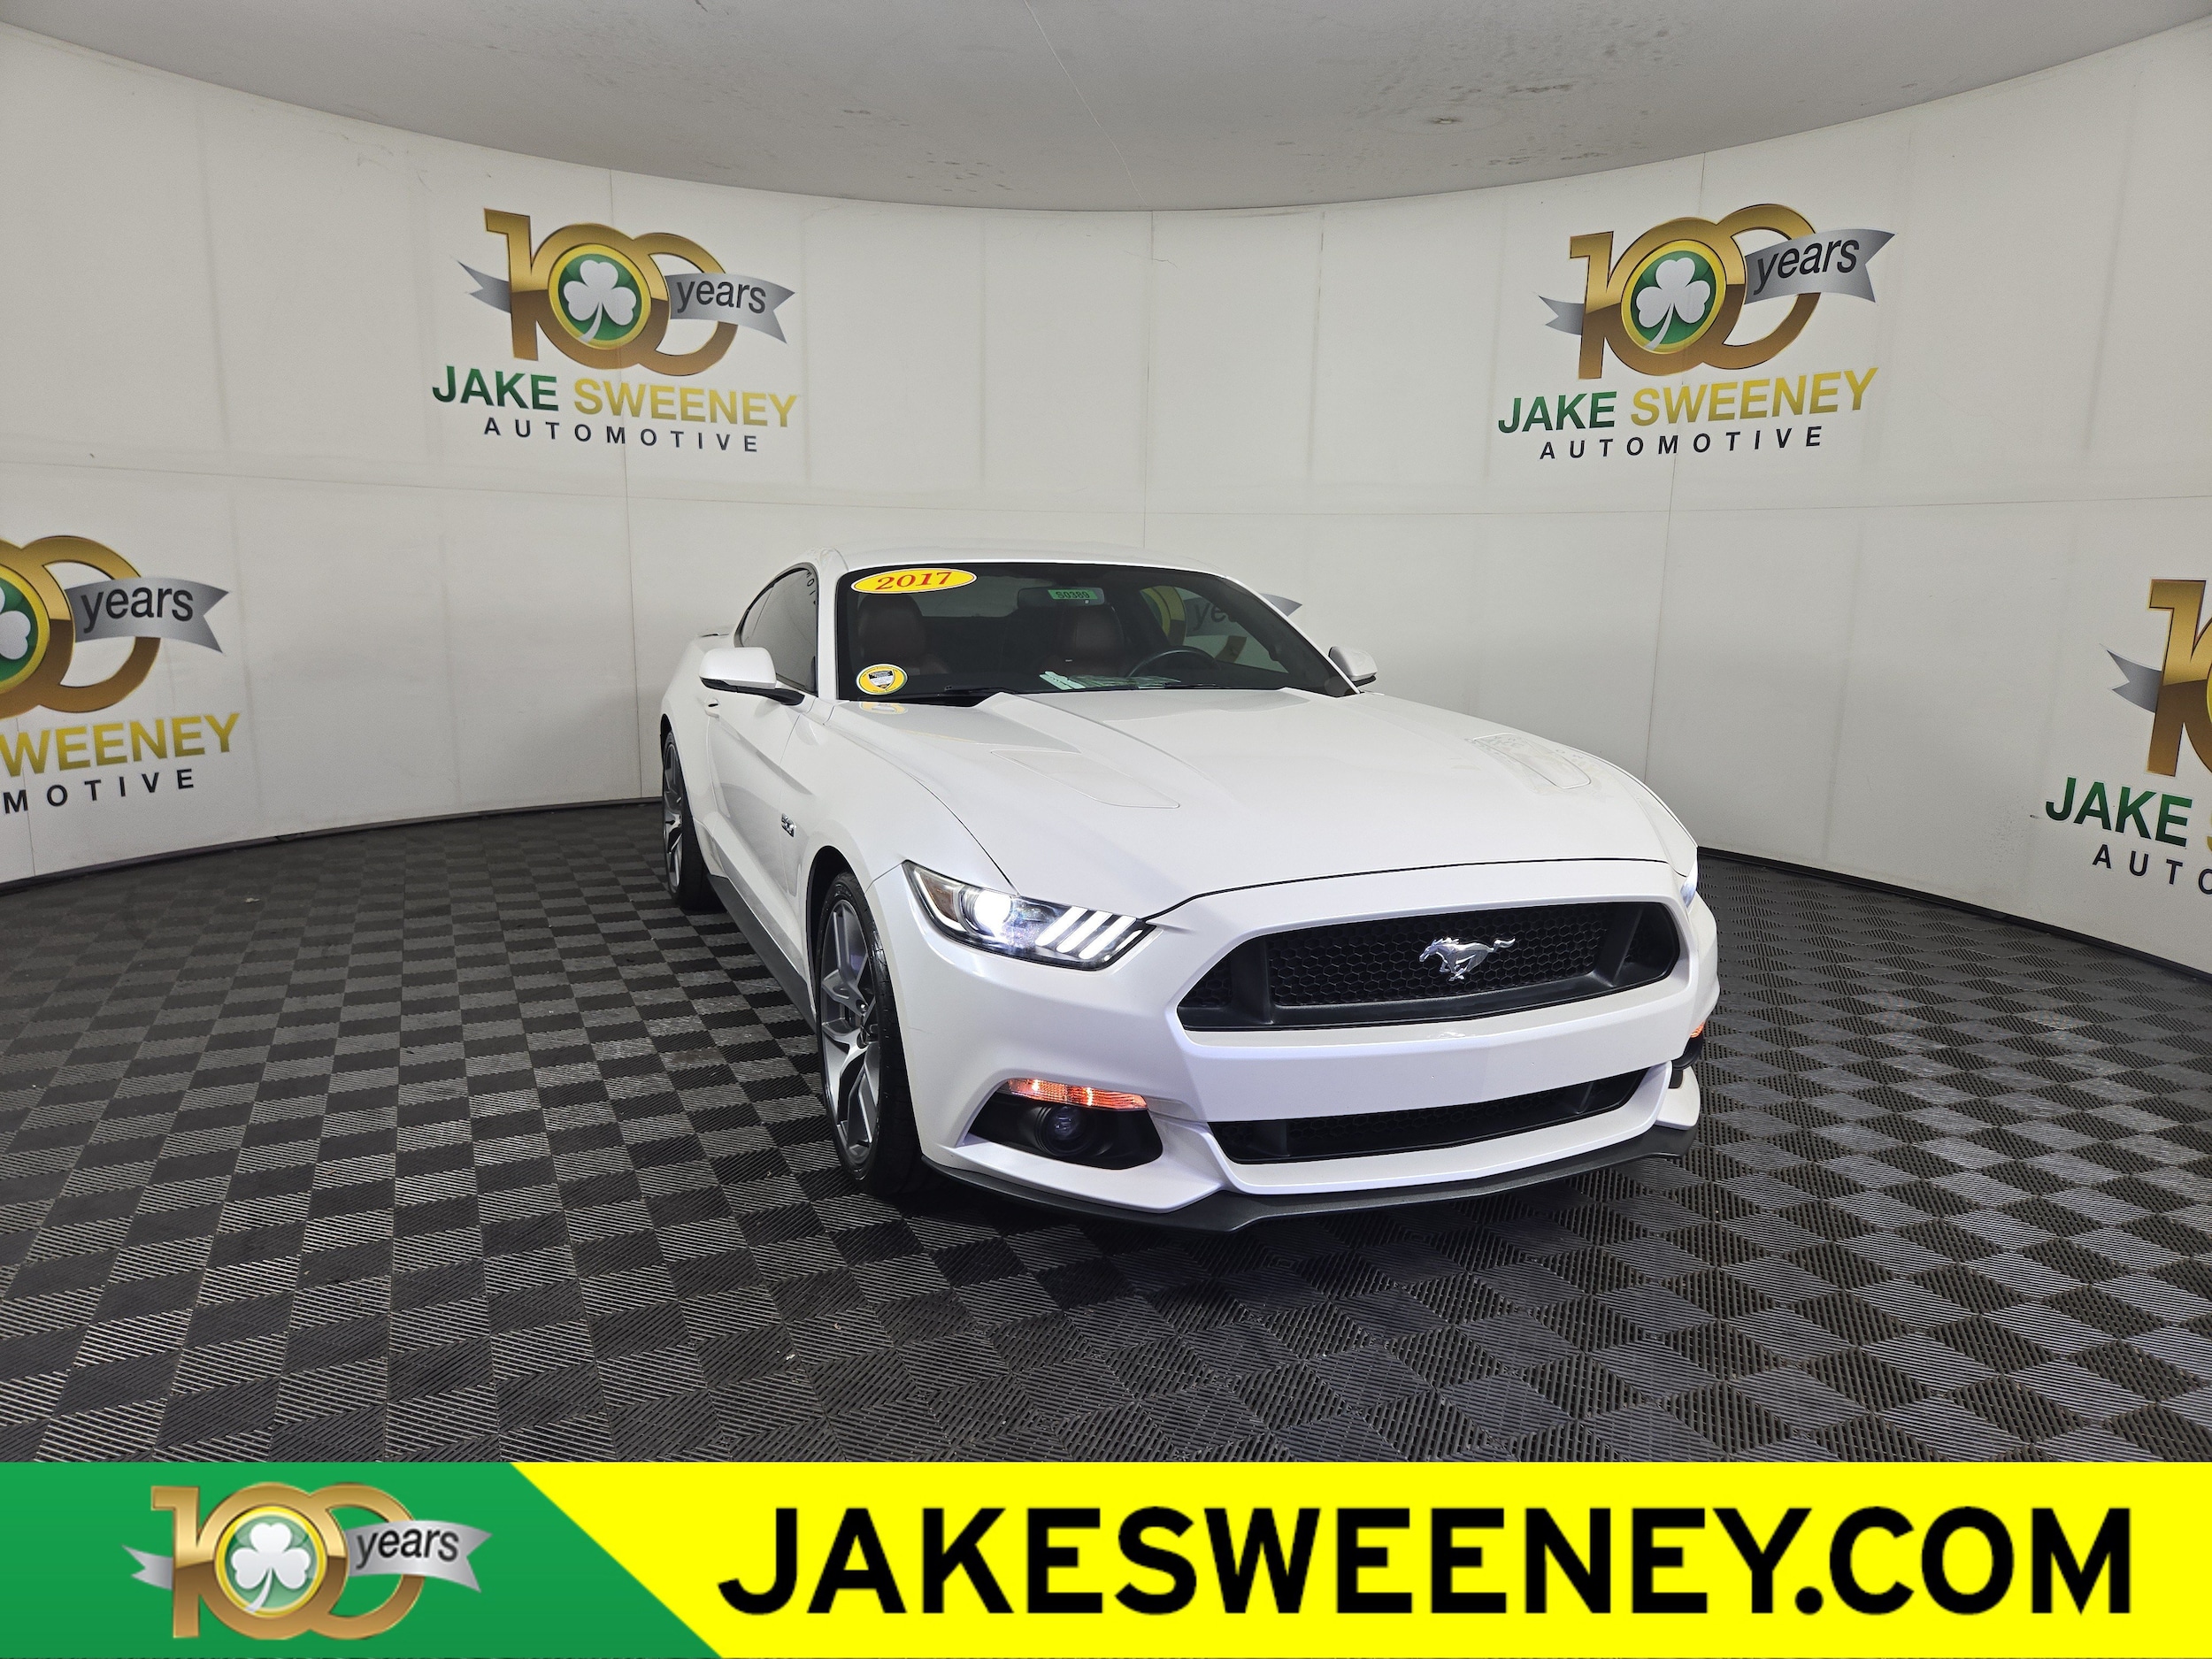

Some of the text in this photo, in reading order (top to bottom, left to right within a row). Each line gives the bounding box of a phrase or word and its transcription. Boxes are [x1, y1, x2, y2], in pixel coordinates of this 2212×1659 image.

[1753, 239, 1860, 296] years
[676, 280, 766, 314] years
[432, 365, 797, 428] JAKE SWEENEY
[1497, 367, 1879, 434] JAKE SWEENEY
[484, 417, 758, 452] AUTOMOTIVE
[1540, 426, 1824, 460] AUTOMOTIVE
[875, 572, 952, 590] 2017
[81, 586, 195, 634] years
[3, 768, 195, 814] MOTIVE
[2045, 776, 2193, 848] JAKE
